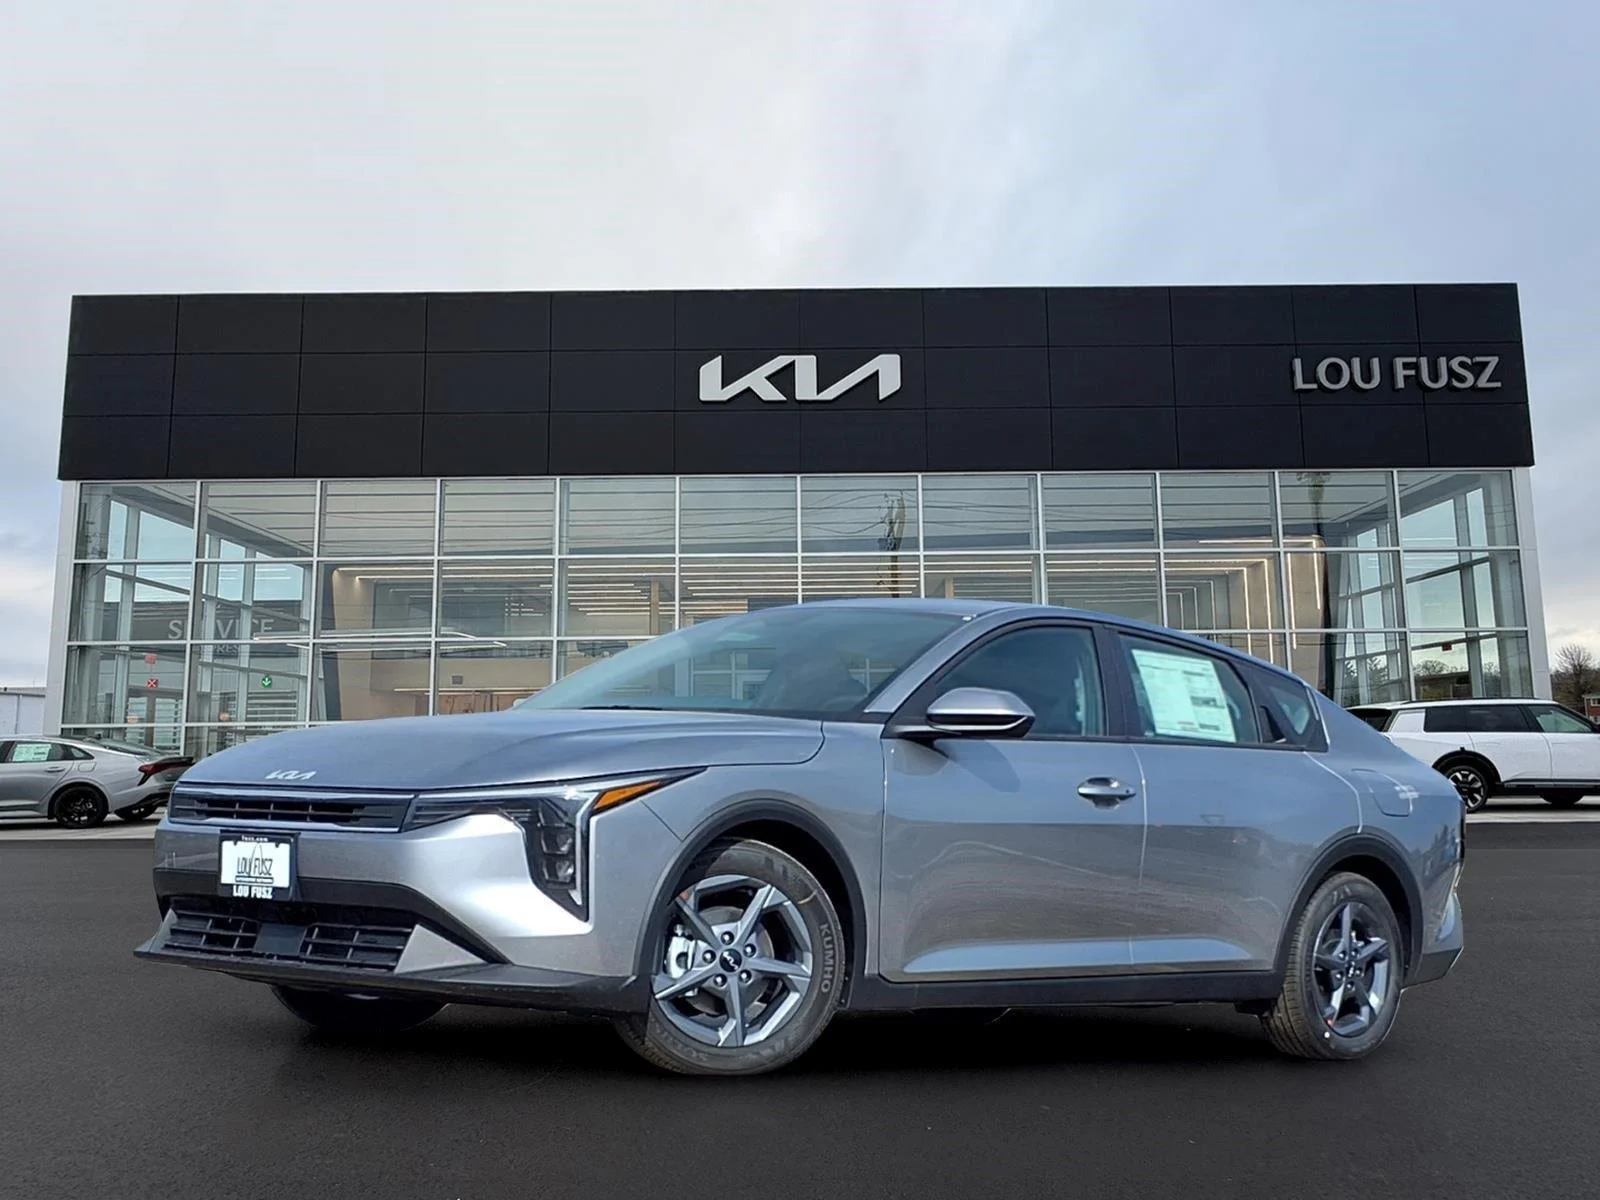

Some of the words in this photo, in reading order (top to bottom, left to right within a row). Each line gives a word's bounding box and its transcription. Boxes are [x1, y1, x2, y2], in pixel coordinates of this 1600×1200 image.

[699, 353, 901, 402] KIA
[1292, 356, 1381, 391] LOU
[1392, 355, 1502, 390] FUSZ
[265, 769, 317, 780] KIA
[237, 856, 251, 876] LOU
[253, 857, 273, 877] FUSZ
[232, 884, 250, 898] LOU
[250, 885, 273, 900] FUSZ
[820, 923, 834, 993] KUMHO
